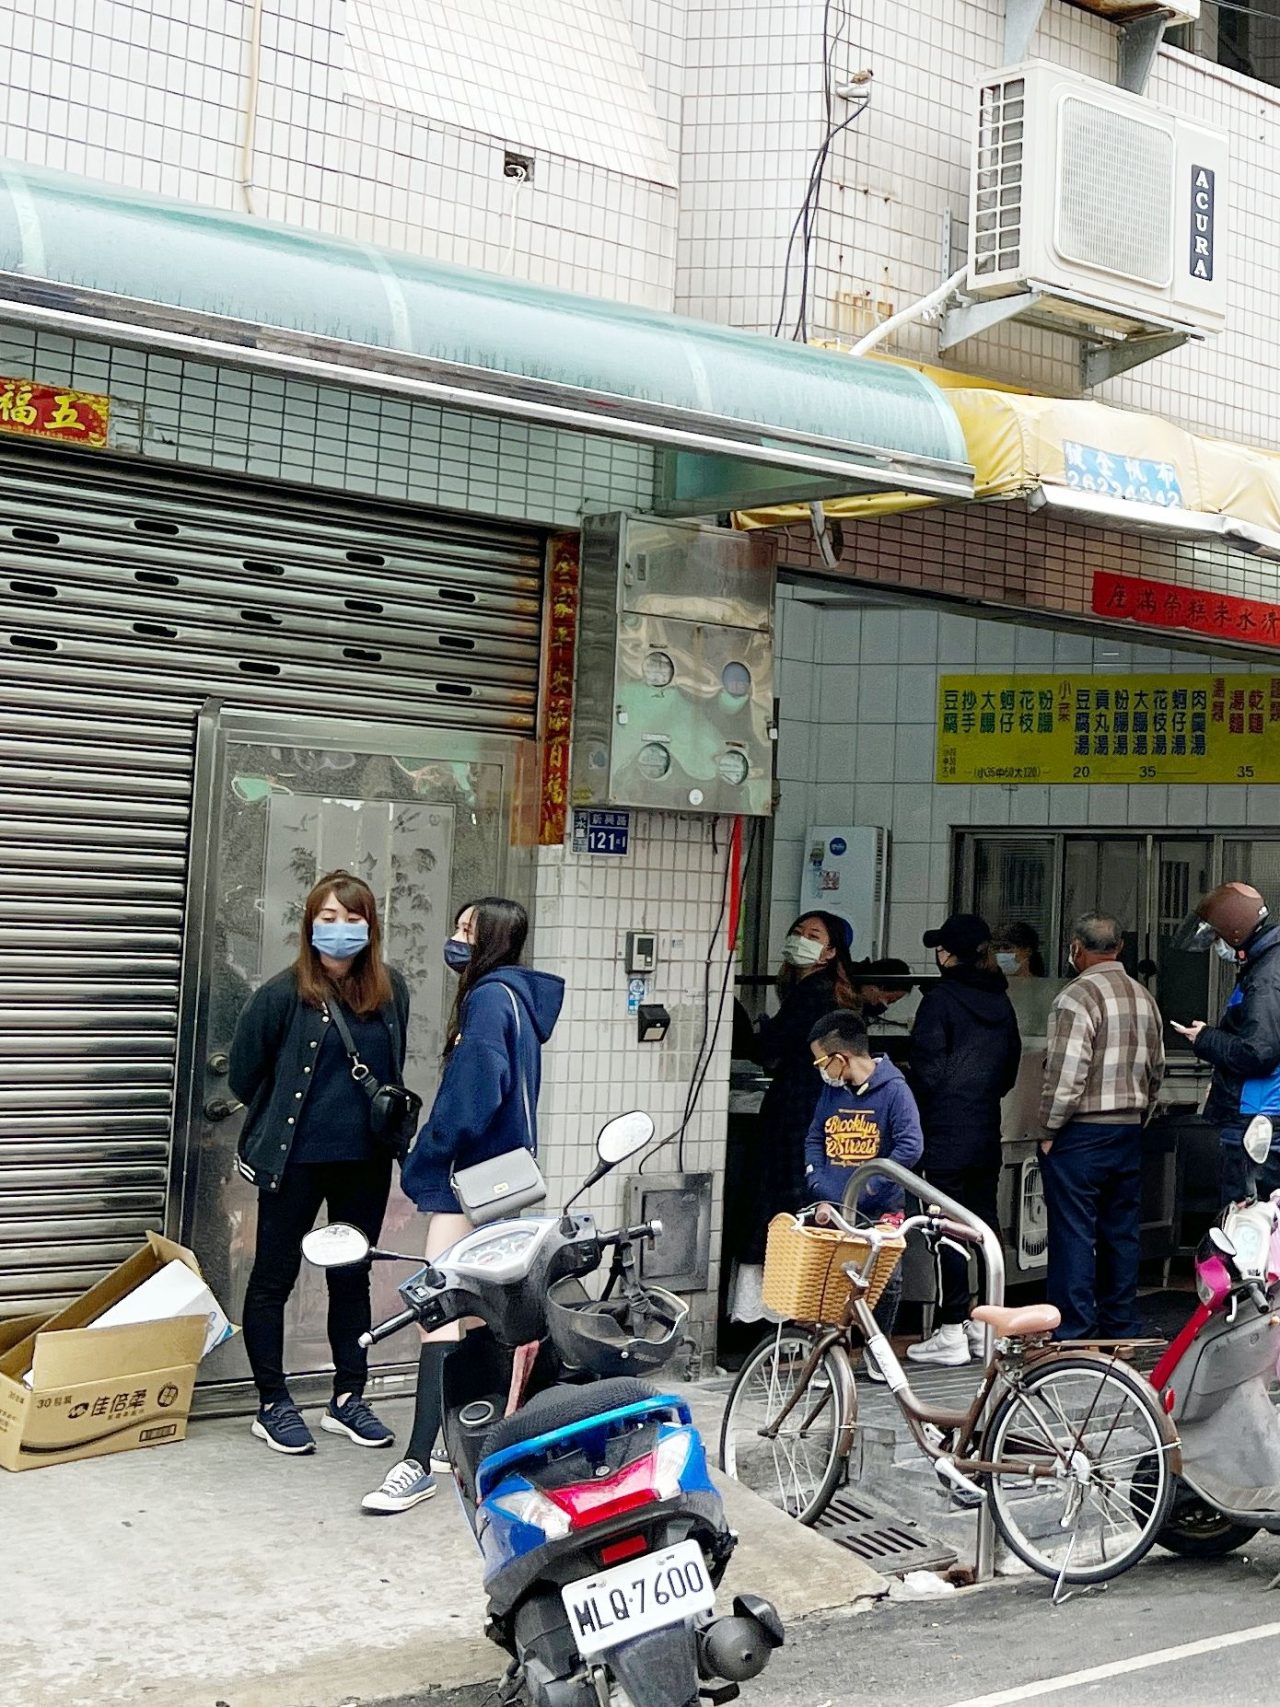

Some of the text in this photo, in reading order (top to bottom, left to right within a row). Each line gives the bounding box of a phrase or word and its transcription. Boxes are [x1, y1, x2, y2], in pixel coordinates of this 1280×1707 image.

[1194, 168, 1210, 277] ACURA
[1019, 689, 1035, 733] 花枝
[1073, 766, 1090, 778] 20
[1138, 766, 1156, 778] 35
[1237, 766, 1254, 778] 35
[825, 1114, 878, 1137] Brooklyn
